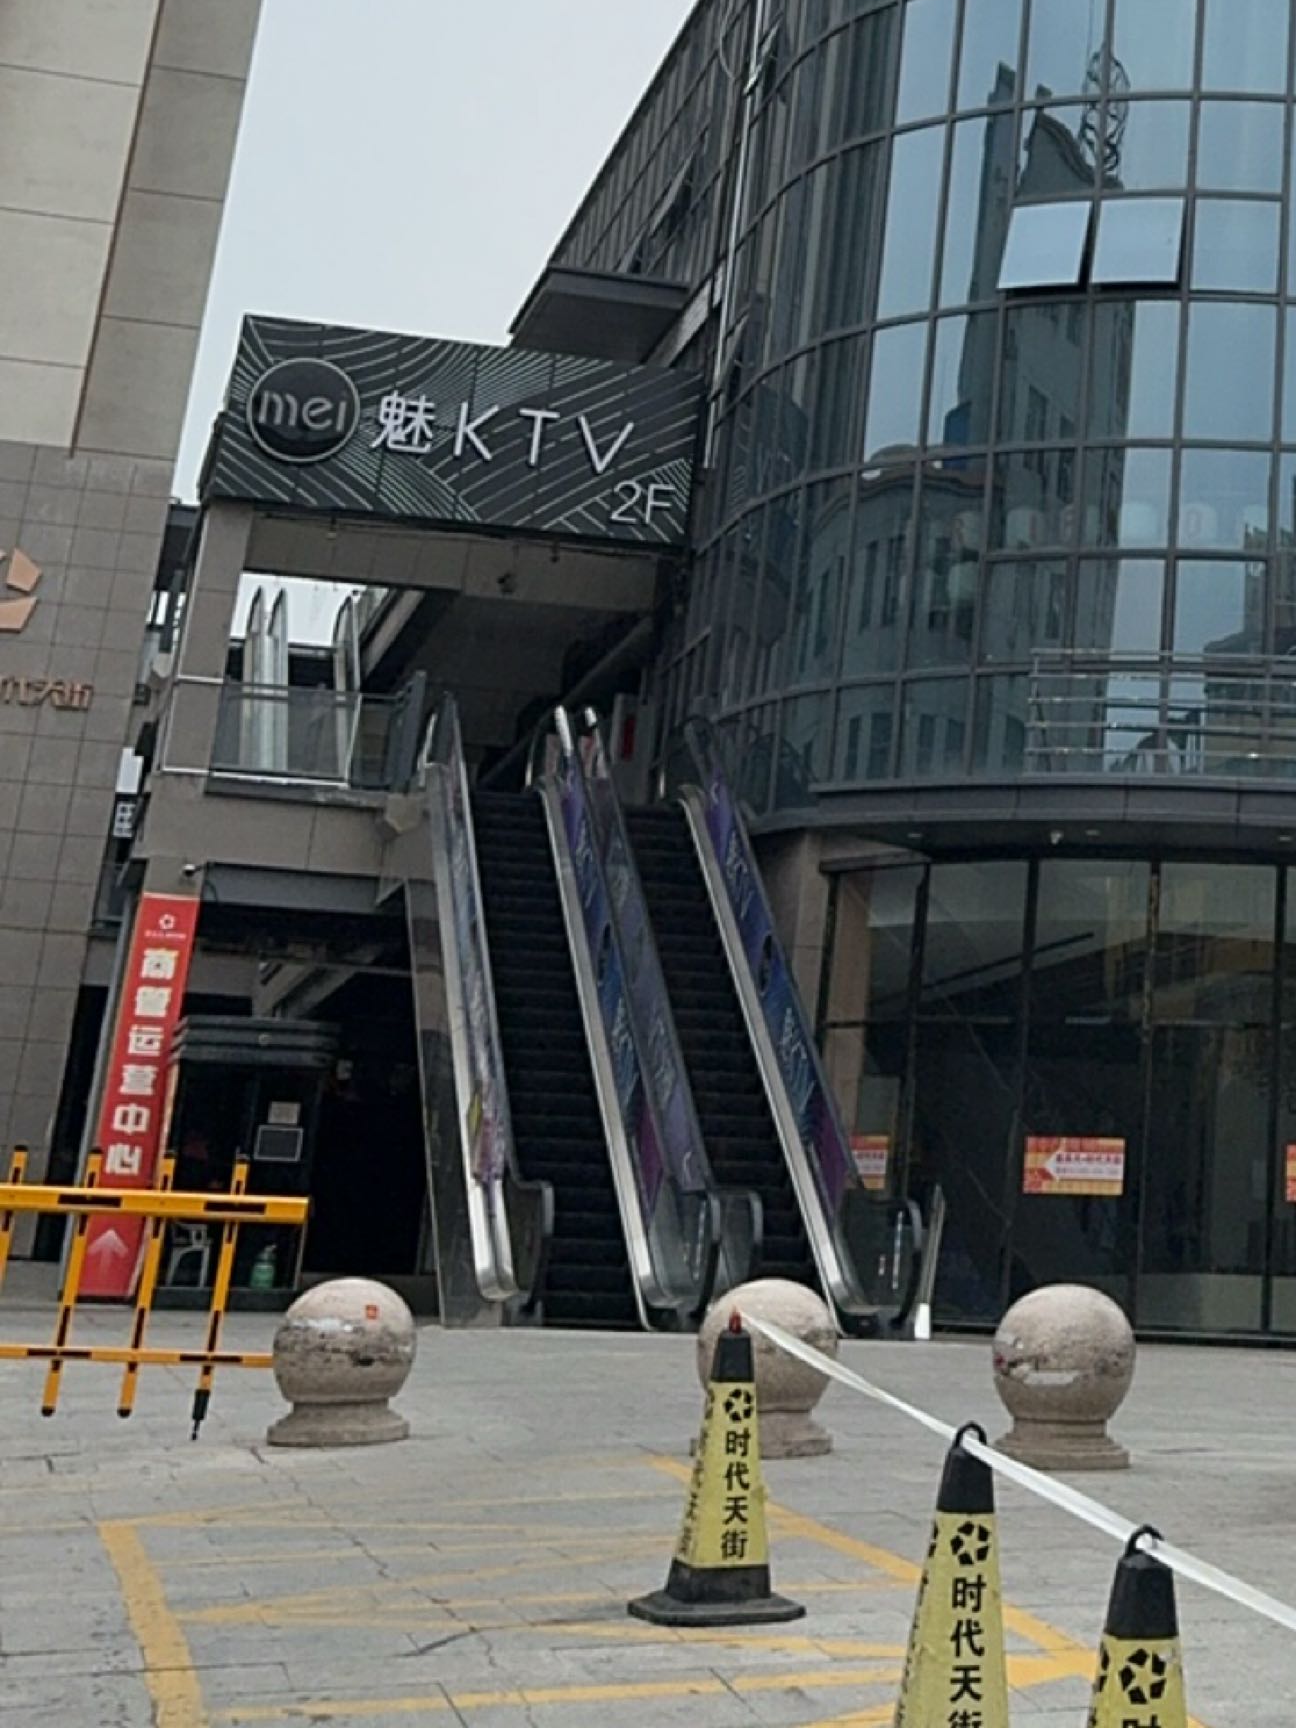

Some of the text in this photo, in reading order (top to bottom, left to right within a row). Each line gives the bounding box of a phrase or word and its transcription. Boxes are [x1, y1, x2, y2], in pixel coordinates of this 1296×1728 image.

[259, 389, 348, 433] mei
[609, 480, 677, 526] 2F
[721, 1426, 752, 1561] 时代天街
